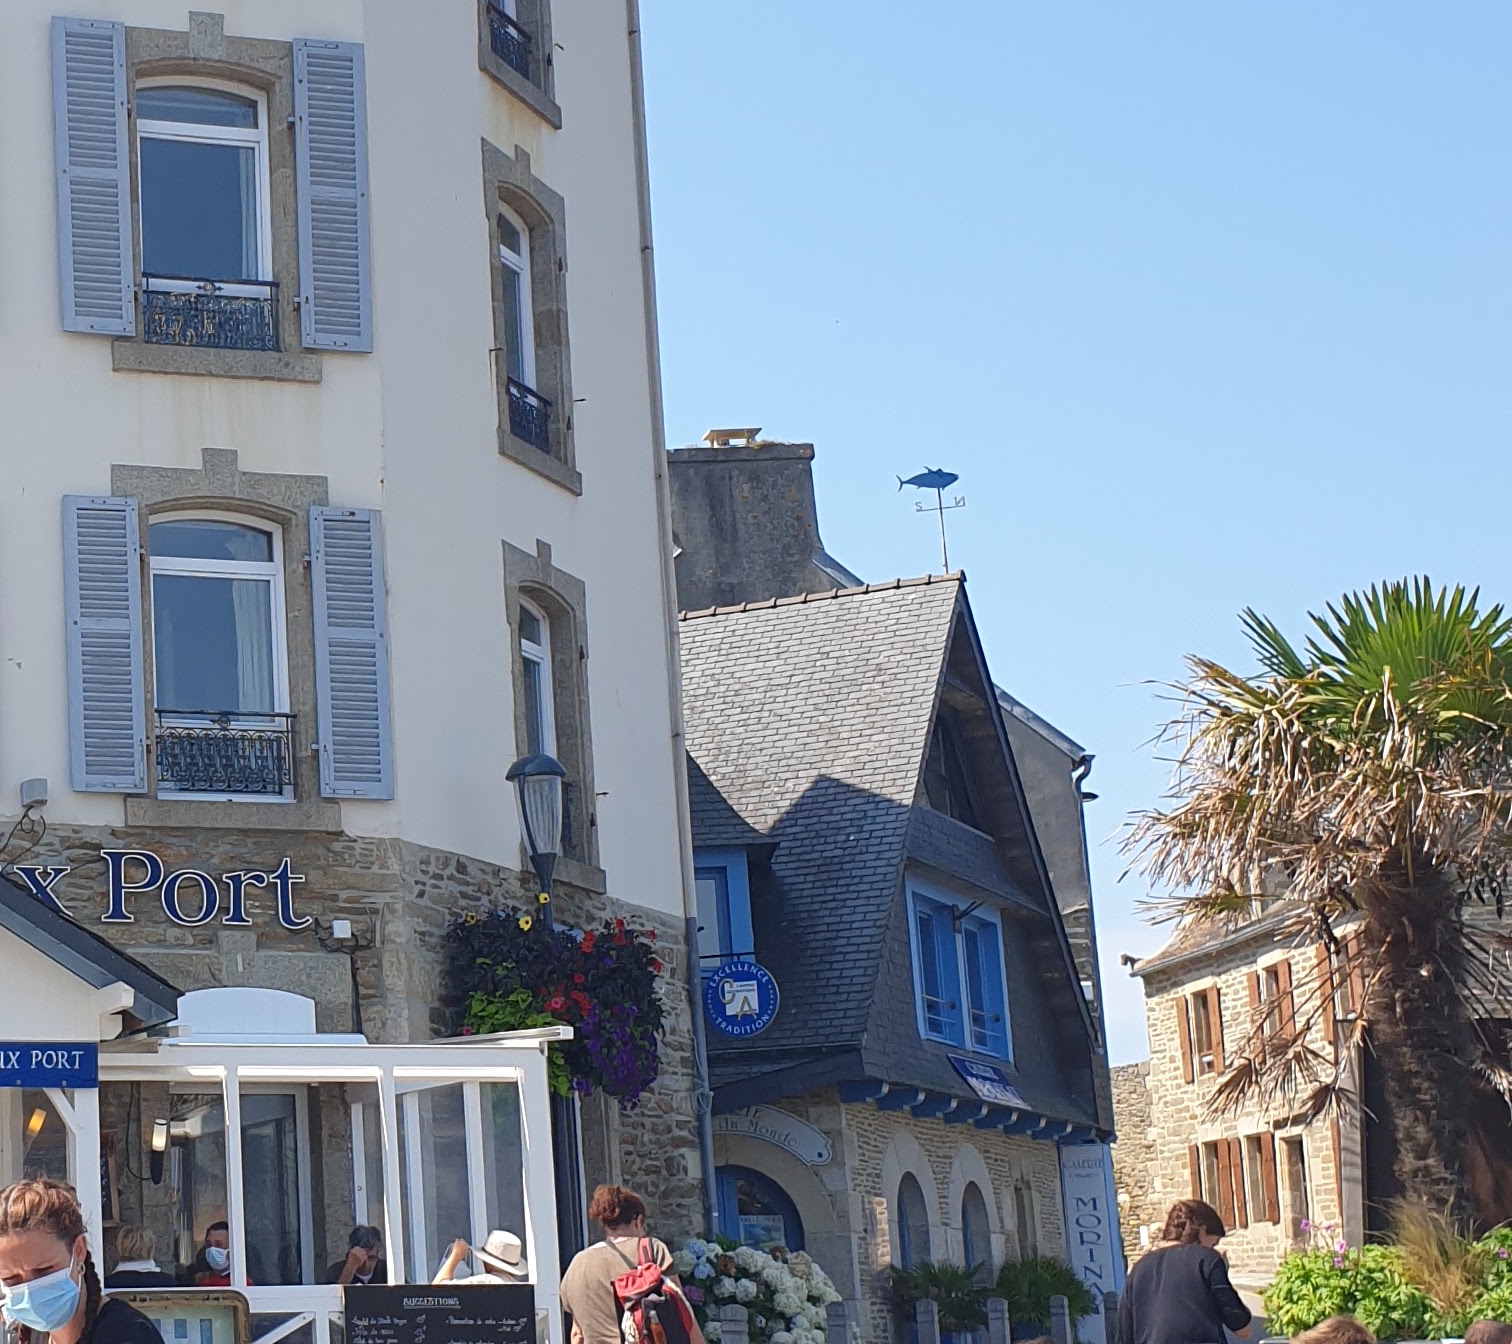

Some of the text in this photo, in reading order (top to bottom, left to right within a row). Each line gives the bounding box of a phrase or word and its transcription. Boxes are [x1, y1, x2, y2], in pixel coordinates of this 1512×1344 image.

[101, 849, 313, 929] Port
[710, 964, 769, 987] EXCELLENCE
[715, 1014, 770, 1034] TRADITION
[30, 1050, 85, 1069] PORT
